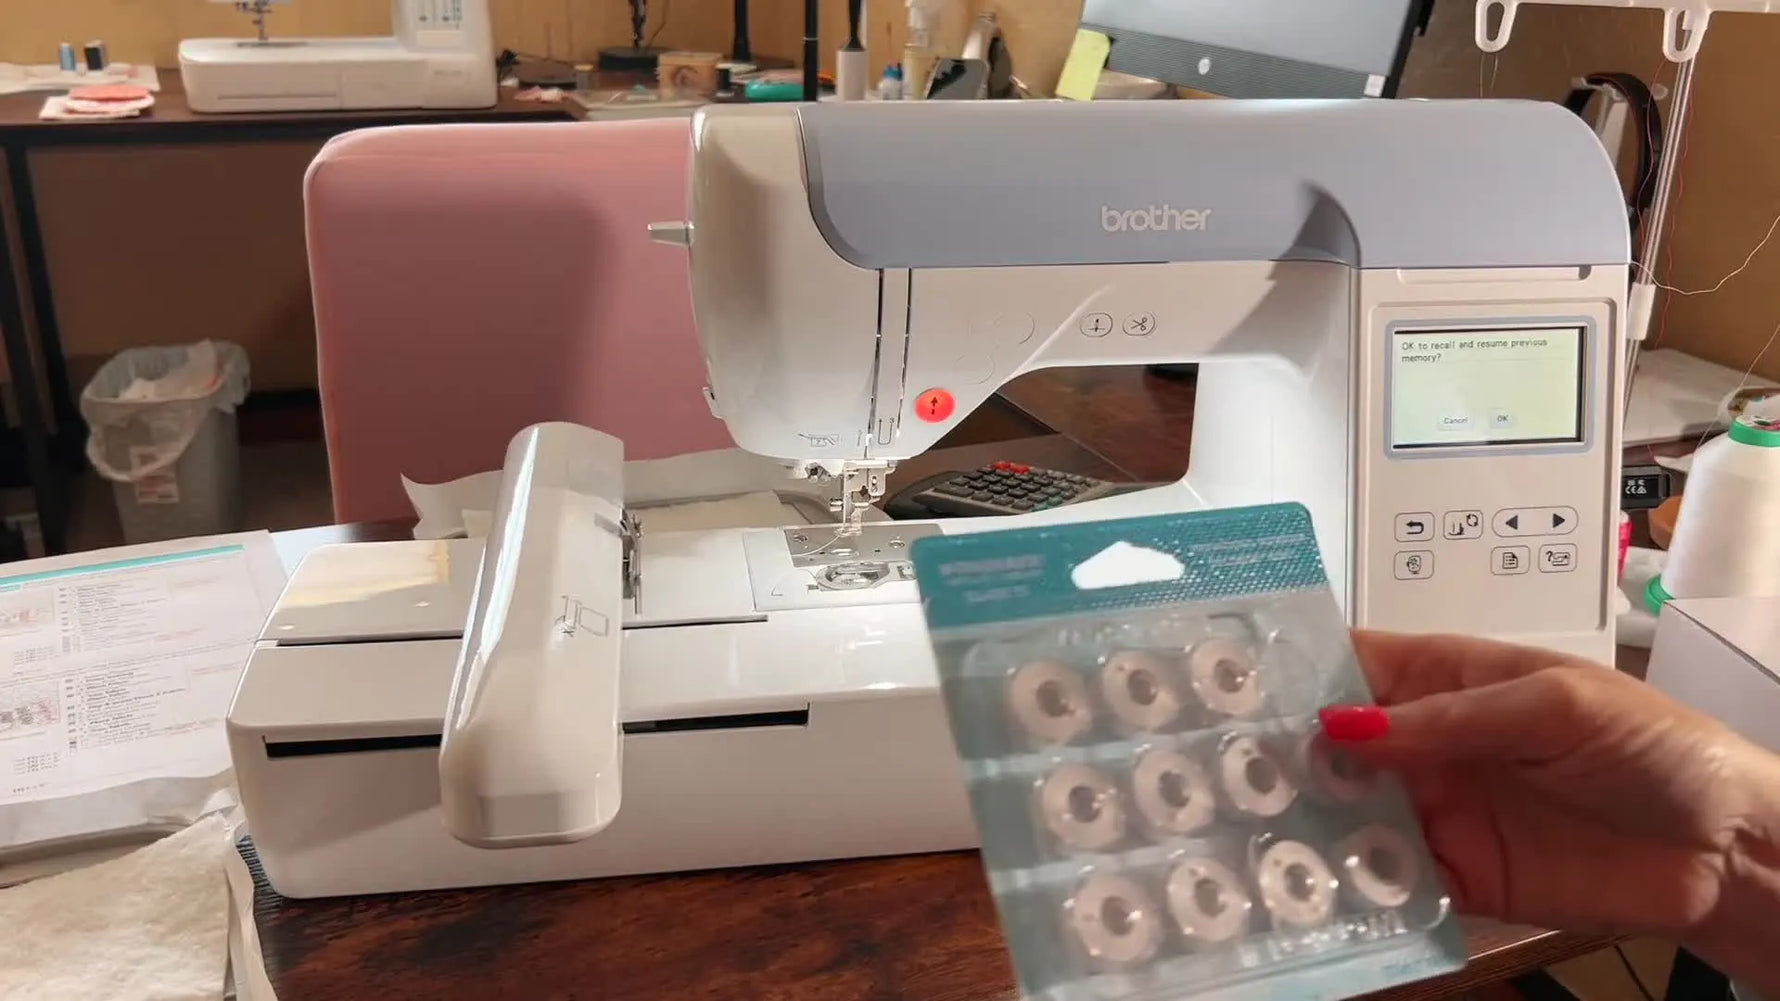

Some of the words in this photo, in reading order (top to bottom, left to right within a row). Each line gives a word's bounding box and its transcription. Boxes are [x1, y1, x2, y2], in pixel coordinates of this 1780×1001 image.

[1101, 204, 1212, 232] brother
[1401, 342, 1414, 351] OK
[1418, 342, 1428, 350] to
[1431, 340, 1455, 350] recall
[1459, 340, 1474, 348] and
[1477, 340, 1508, 348] resume
[1511, 338, 1548, 348] previous
[1401, 353, 1442, 363] memory?
